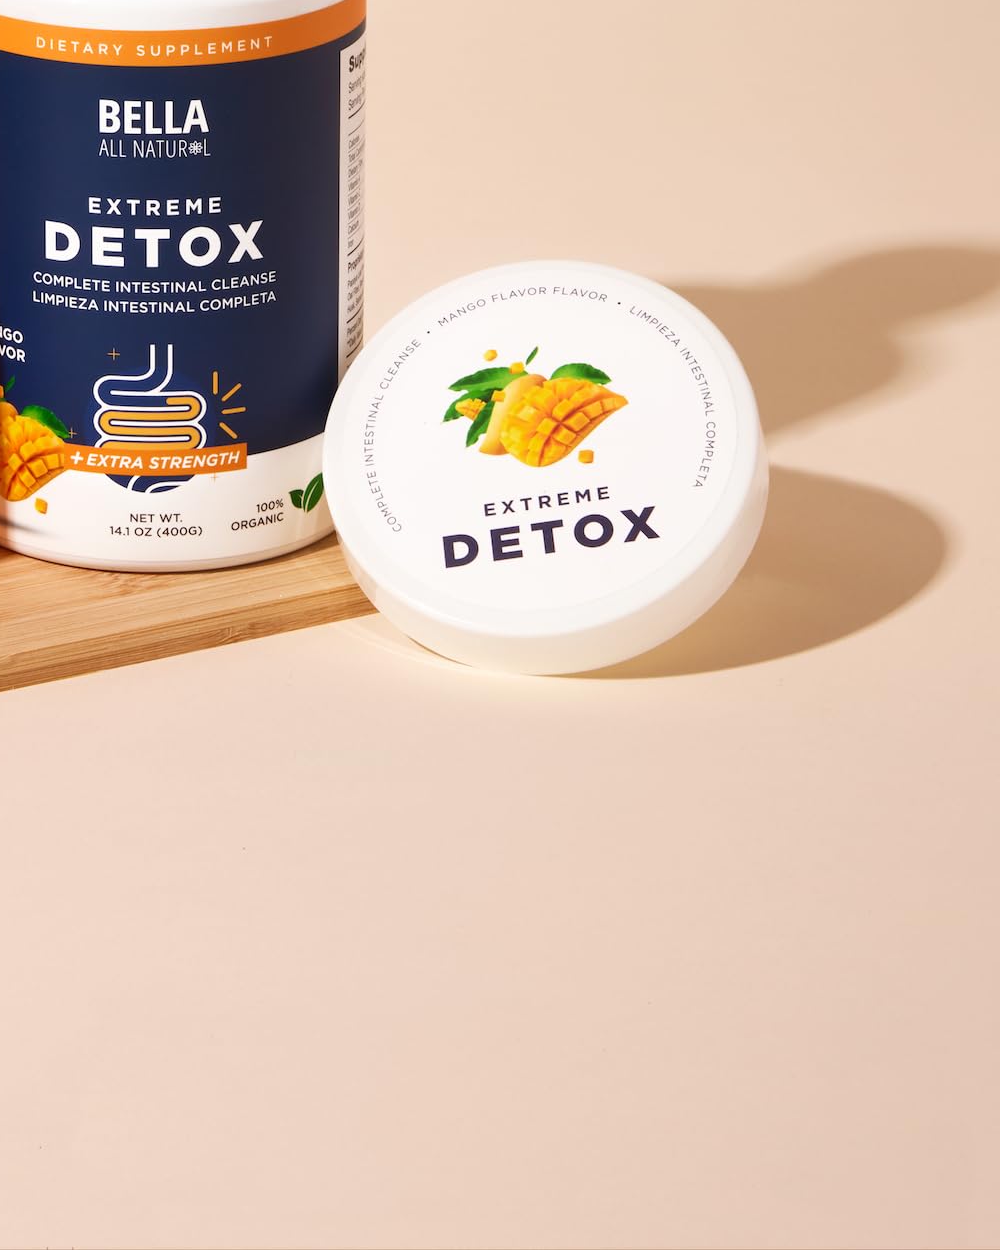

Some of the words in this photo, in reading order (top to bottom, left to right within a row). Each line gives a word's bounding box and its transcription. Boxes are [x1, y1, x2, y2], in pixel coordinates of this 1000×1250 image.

[36, 36, 123, 56] DIETARY
[136, 36, 273, 57] SUPPLEMENT
[99, 99, 209, 135] BELLA
[99, 138, 127, 158] ALL
[133, 138, 211, 158] NATURL
[88, 197, 222, 216] EXTREME
[45, 220, 264, 268] DETOX
[33, 271, 110, 292] COMPLETE
[116, 281, 207, 293] INTESTINAL
[211, 270, 277, 291] CLEANSE
[32, 290, 99, 311] LIMPIEZA
[103, 300, 195, 313] INTESTINAL
[199, 291, 277, 312] COMPLETA
[438, 299, 486, 327] MANGO
[491, 287, 547, 302] FLAVOR
[552, 286, 608, 302] FLAVOR
[629, 305, 681, 348] LIMPIEZA
[379, 338, 421, 390] CLEANSE
[680, 347, 714, 417] INTESTINAL
[364, 394, 385, 467] INTESTINAL
[149, 450, 241, 469] STRENGTH
[693, 421, 716, 488] COMPLETA
[256, 498, 284, 513] 100%
[367, 470, 402, 532] COMPLETE
[484, 486, 610, 516] EXTREME
[109, 526, 130, 536] 14.1
[134, 527, 152, 537] OZ
[156, 526, 203, 538] (400G)
[129, 513, 155, 523] NET
[159, 513, 183, 523] WT.
[231, 512, 284, 531] ORGANIC
[442, 506, 660, 568] DETOX
